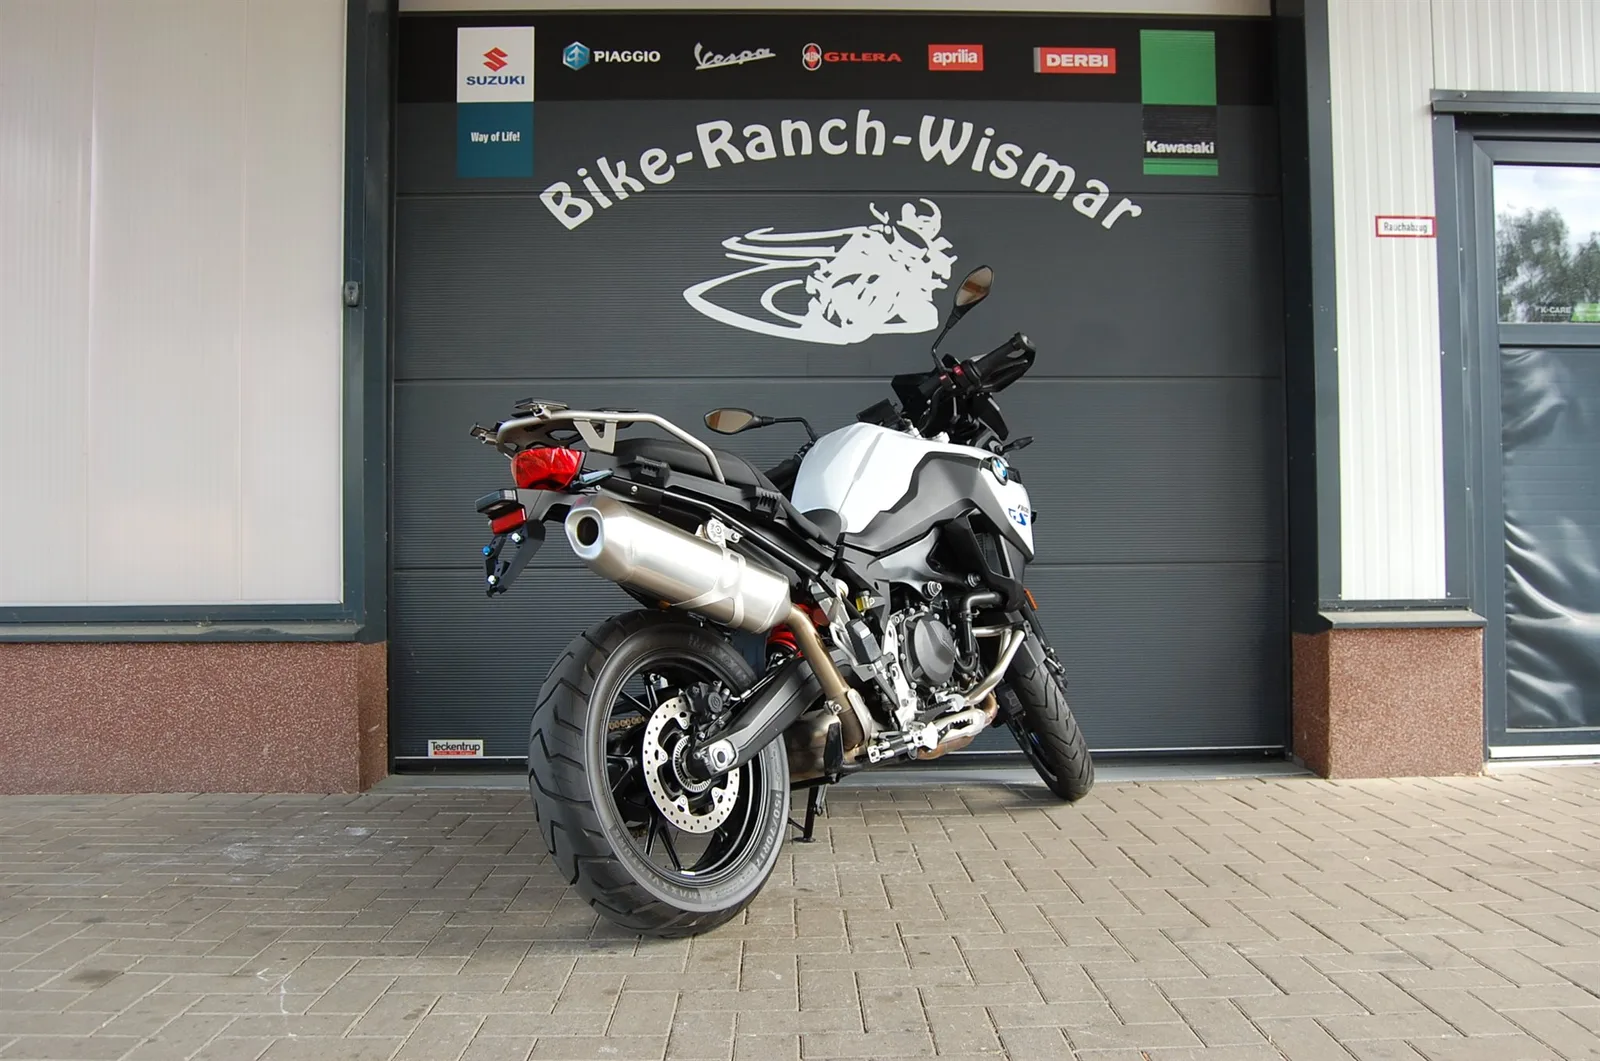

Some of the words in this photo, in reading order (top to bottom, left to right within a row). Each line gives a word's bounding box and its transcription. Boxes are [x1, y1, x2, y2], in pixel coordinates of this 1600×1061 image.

[593, 49, 661, 63] PIAGGIO
[693, 42, 777, 71] Vespa
[823, 51, 902, 62] GILERA
[932, 49, 978, 66] aprilia
[1046, 53, 1109, 68] DERBI
[466, 75, 525, 86] SUZUKI
[471, 131, 489, 144] Way
[491, 131, 499, 142] of
[501, 131, 520, 142] Life!
[1145, 140, 1215, 155] Kawasaki
[539, 108, 1143, 231] Bike-Ranch-Wismar
[1383, 222, 1428, 234] Rauchabzug
[431, 742, 480, 755] Teckentrup
[756, 792, 782, 868] 150/70R17
